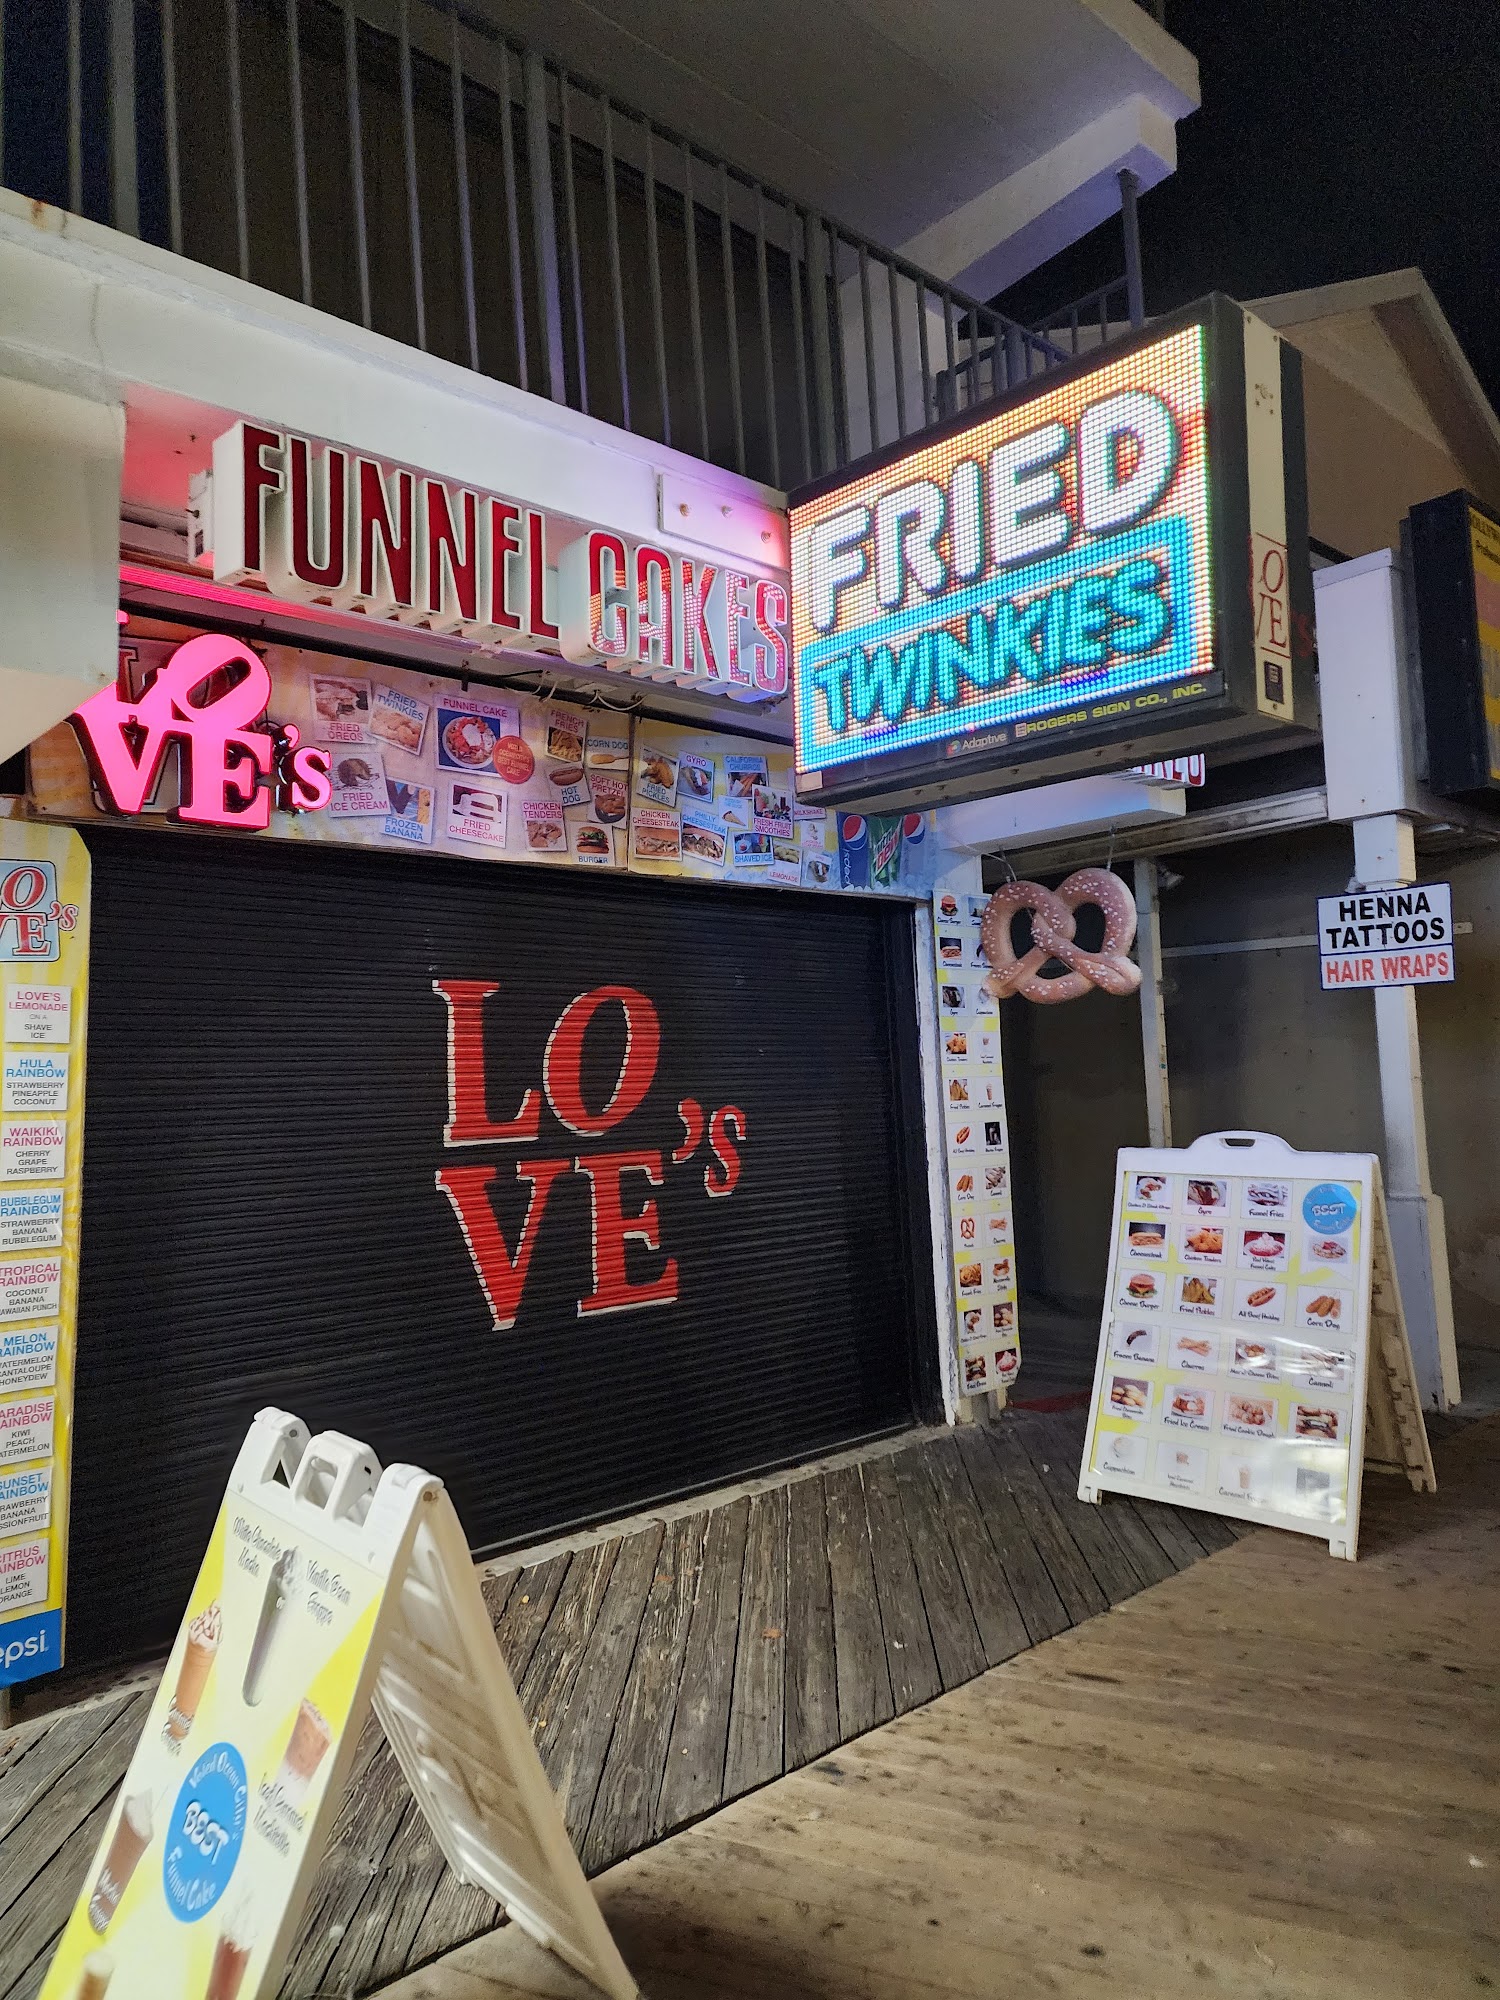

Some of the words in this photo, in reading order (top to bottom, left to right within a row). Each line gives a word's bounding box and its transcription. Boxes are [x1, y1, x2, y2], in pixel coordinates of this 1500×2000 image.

[810, 389, 1178, 632] FRIED
[242, 424, 560, 640] FUNNEL
[589, 530, 789, 696] CAKES
[813, 559, 1168, 733] TWINKIES
[388, 690, 417, 708] FRIED
[377, 694, 424, 721] TWINKIES
[443, 698, 480, 713] FUNNEL
[483, 705, 508, 718] CAKE
[1026, 711, 1087, 734] ROGERS
[1092, 701, 1130, 718] SIGN
[1173, 683, 1207, 698] INC.
[550, 710, 584, 727] FRENCH
[329, 722, 360, 732] FRIED
[555, 719, 579, 733] FRIES
[328, 731, 363, 741] OREOS
[963, 731, 1007, 750] Adaptive
[587, 739, 610, 748] CORN
[611, 741, 629, 750] DOG
[686, 754, 706, 767] GYRO
[590, 774, 611, 786] SOFT
[612, 780, 629, 791] HOT
[561, 785, 578, 796] HOT
[647, 783, 666, 795] FRIED
[342, 792, 373, 801] FRIED
[562, 795, 581, 804] DOG
[642, 789, 670, 803] PICKLES
[331, 802, 348, 811] ICE
[351, 800, 388, 811] CREAM
[523, 802, 561, 811] CHICKEN
[523, 810, 562, 819] TENDERS
[640, 810, 671, 819] CHICKEN
[694, 810, 716, 822] PHILLY
[385, 816, 423, 832] FROZEN
[463, 818, 490, 831] FRIED
[632, 817, 679, 828] CHEESESTEAK
[683, 814, 726, 834] CHEESESTEAK
[753, 818, 771, 827] FRESH
[772, 821, 792, 831] FRUIT
[384, 825, 423, 841] BANANA
[449, 825, 504, 842] CHEESECAKE
[754, 825, 790, 837] SMOOTHIES
[578, 855, 608, 864] BURGER
[734, 855, 761, 863] SHAVED
[769, 871, 799, 883] LEMONADE
[0, 866, 48, 912] O
[1339, 892, 1431, 922] HENNA
[1326, 917, 1445, 949] TATTOOS
[1326, 958, 1375, 984] HAIR
[1381, 951, 1449, 980] WRAPS
[17, 991, 61, 1002] LOVE'S
[8, 1001, 69, 1012] LEMONADE
[24, 1023, 53, 1031] SHAVE
[30, 1031, 46, 1040] ICE
[19, 1059, 54, 1069] HULA
[5, 1068, 67, 1079] RAINBOW
[6, 1081, 64, 1089] STRAWBERRY
[13, 1098, 57, 1106] COCONUT
[9, 1126, 58, 1137] WAIKIKI
[3, 1136, 64, 1147] RAINBOW
[15, 1150, 51, 1158] CHERRY
[18, 1158, 48, 1166] GRAPE
[6, 1166, 58, 1175] RASPBERRY
[0, 1194, 61, 1207] BUBBLEGUM
[0, 1204, 61, 1217] RAINBOW
[1197, 1206, 1213, 1216] Gyro
[1248, 1208, 1269, 1217] Funnel
[1269, 1209, 1285, 1218] Fries
[0, 1217, 60, 1228] STRAWBERRY
[12, 1227, 48, 1236] BANANA
[2, 1234, 57, 1246] BUBBLEGUM
[0, 1263, 60, 1276] TROPICAL
[5, 1286, 50, 1298] COCONUT
[9, 1295, 45, 1306] BANANA
[1139, 1300, 1160, 1310] Burger
[0, 1305, 31, 1316] AWAIIAN
[32, 1303, 58, 1312] PUNCH
[1179, 1305, 1194, 1314] Fried
[1306, 1317, 1324, 1327] Corn
[1325, 1319, 1341, 1330] Dog
[4, 1332, 47, 1347] MELON
[0, 1355, 53, 1369] ATERMELON
[0, 1401, 54, 1419] ARADISE
[0, 1412, 52, 1429] AINBOW
[1164, 1416, 1180, 1426] Fried
[1189, 1419, 1210, 1431] Cream
[11, 1428, 31, 1439] KIWI
[1223, 1424, 1237, 1433] Fried
[6, 1437, 35, 1449] PEACH
[0, 1442, 50, 1459] ATERMELON
[0, 1481, 49, 1500] AINBOW
[0, 1495, 48, 1512] RAWBERRY
[0, 1507, 36, 1521] BANANA
[5, 1572, 26, 1585] LIME
[0, 1581, 30, 1595] LEMON
[0, 1628, 47, 1669] psi
[182, 1798, 230, 1866] BEST
